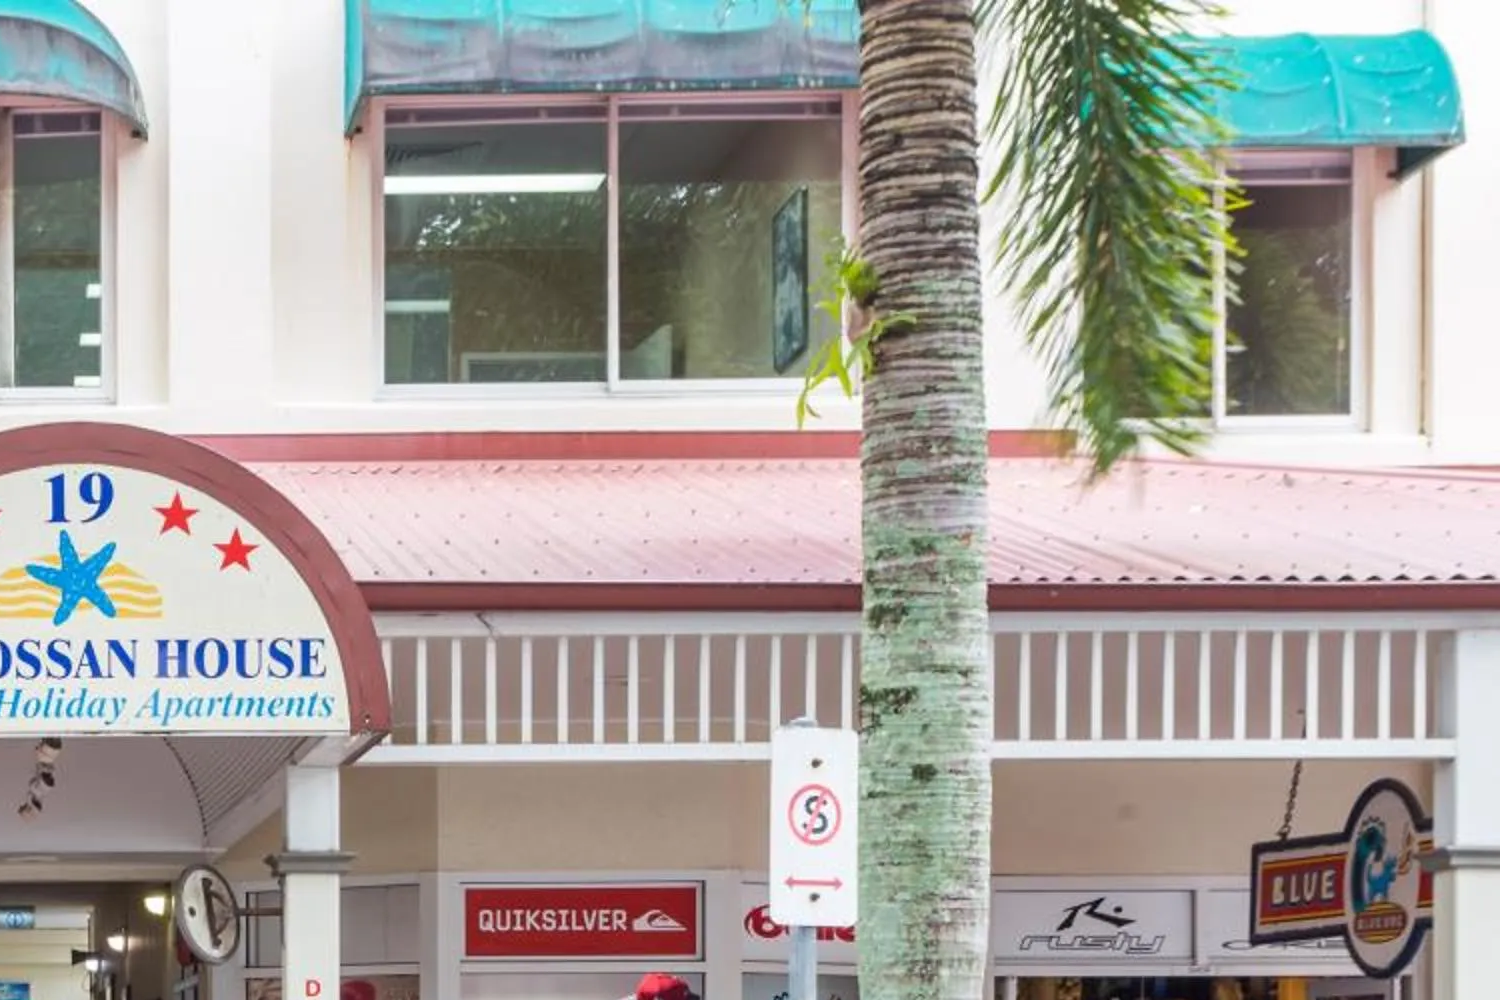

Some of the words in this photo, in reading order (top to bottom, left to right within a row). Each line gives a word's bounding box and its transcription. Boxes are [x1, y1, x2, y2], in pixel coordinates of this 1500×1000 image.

[43, 472, 115, 523] 19
[157, 638, 327, 679] HOUSE
[136, 689, 334, 726] Apartments
[1271, 869, 1336, 908] BLUE
[478, 909, 627, 932] QUIKSILVER
